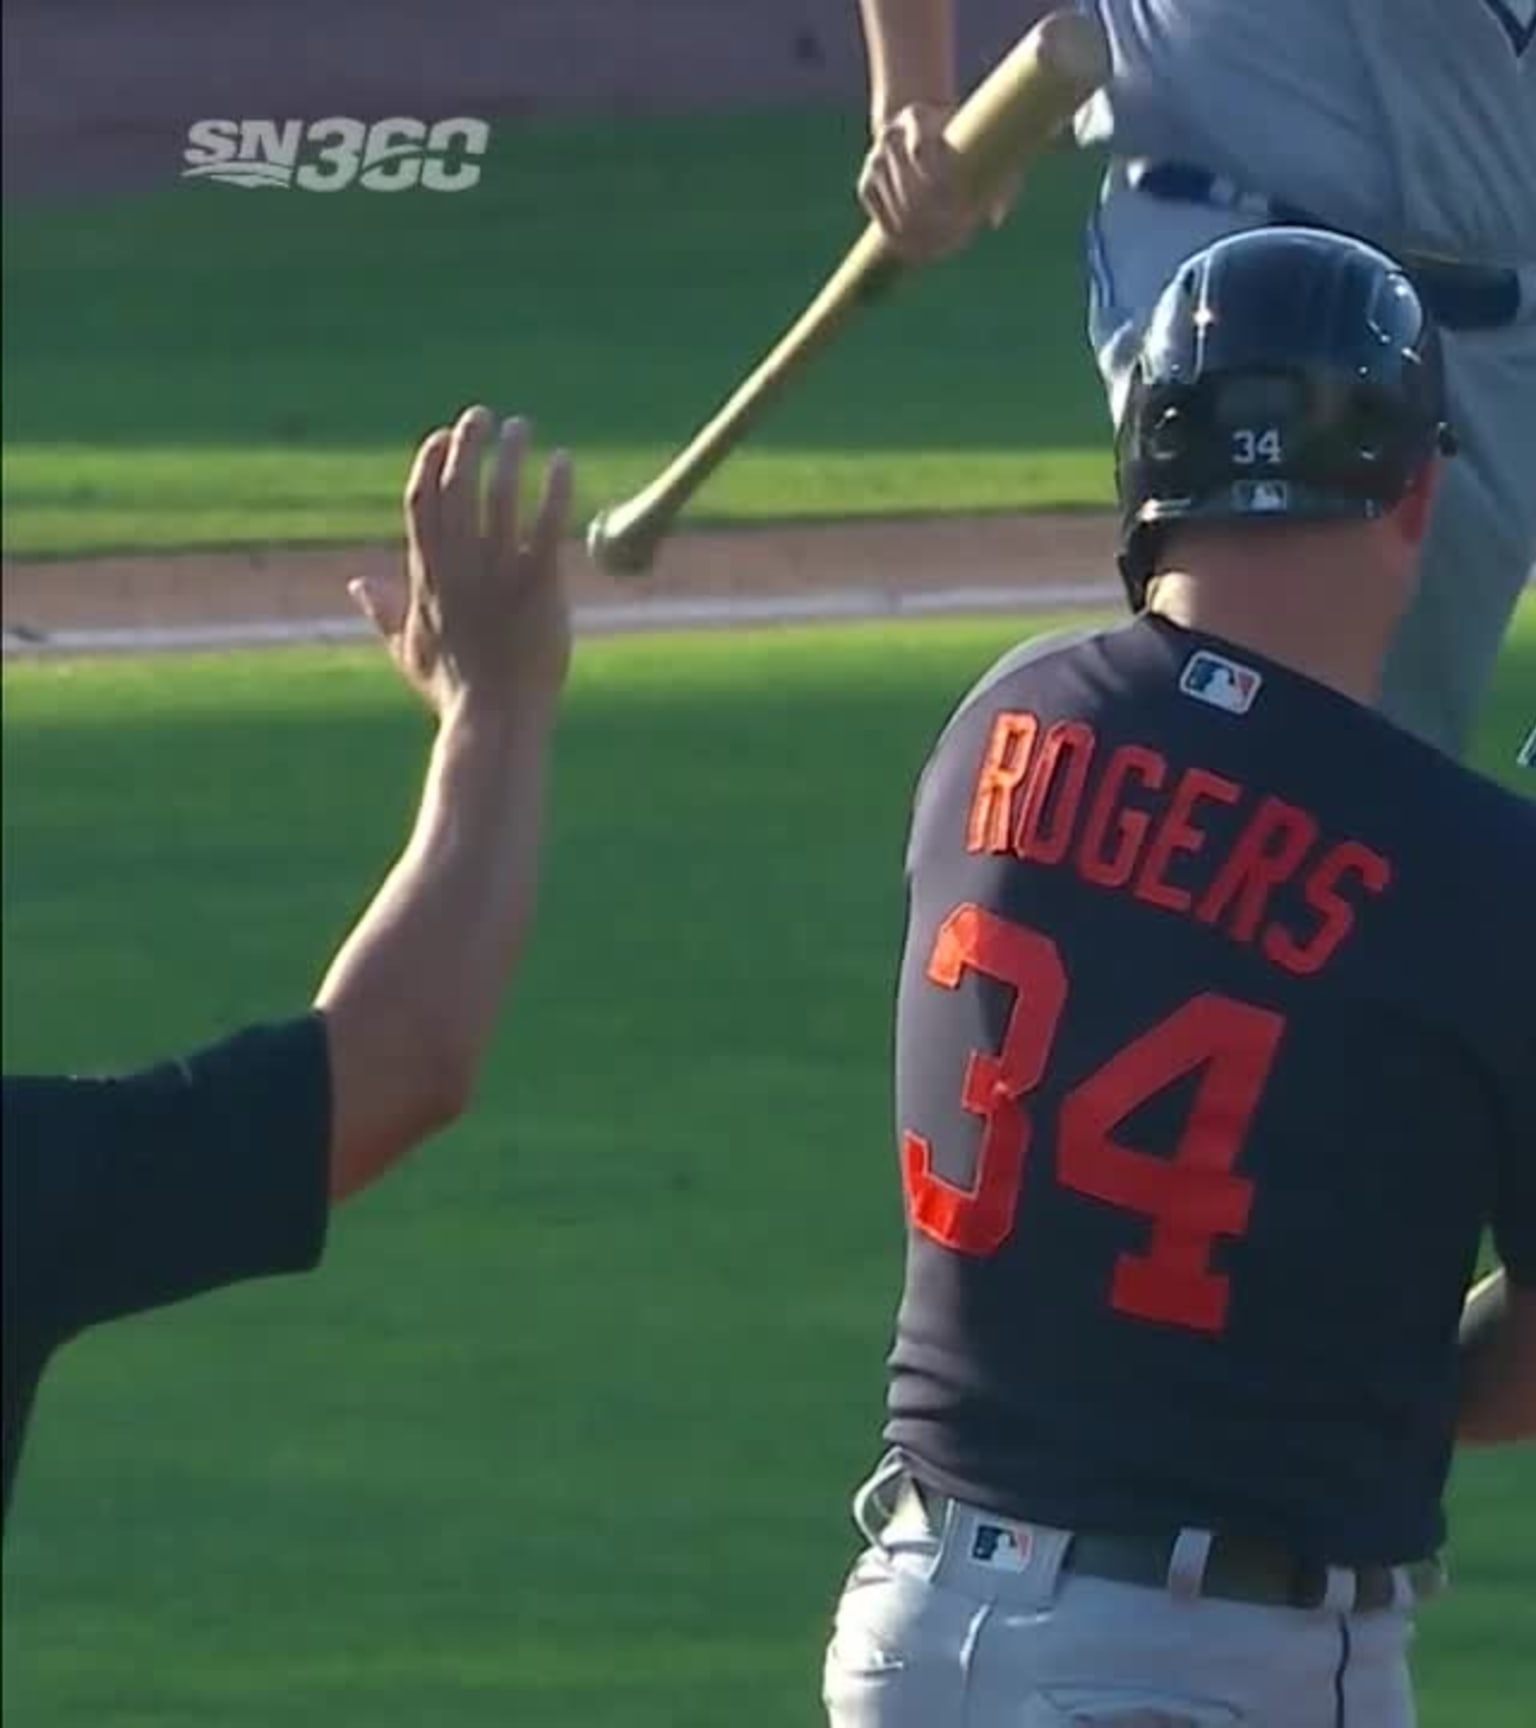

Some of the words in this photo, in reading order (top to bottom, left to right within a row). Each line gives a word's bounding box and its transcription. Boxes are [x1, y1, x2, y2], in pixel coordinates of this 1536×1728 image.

[1233, 429, 1281, 463] 34
[967, 711, 1390, 976] ROGERS
[902, 903, 1286, 1334] 34
